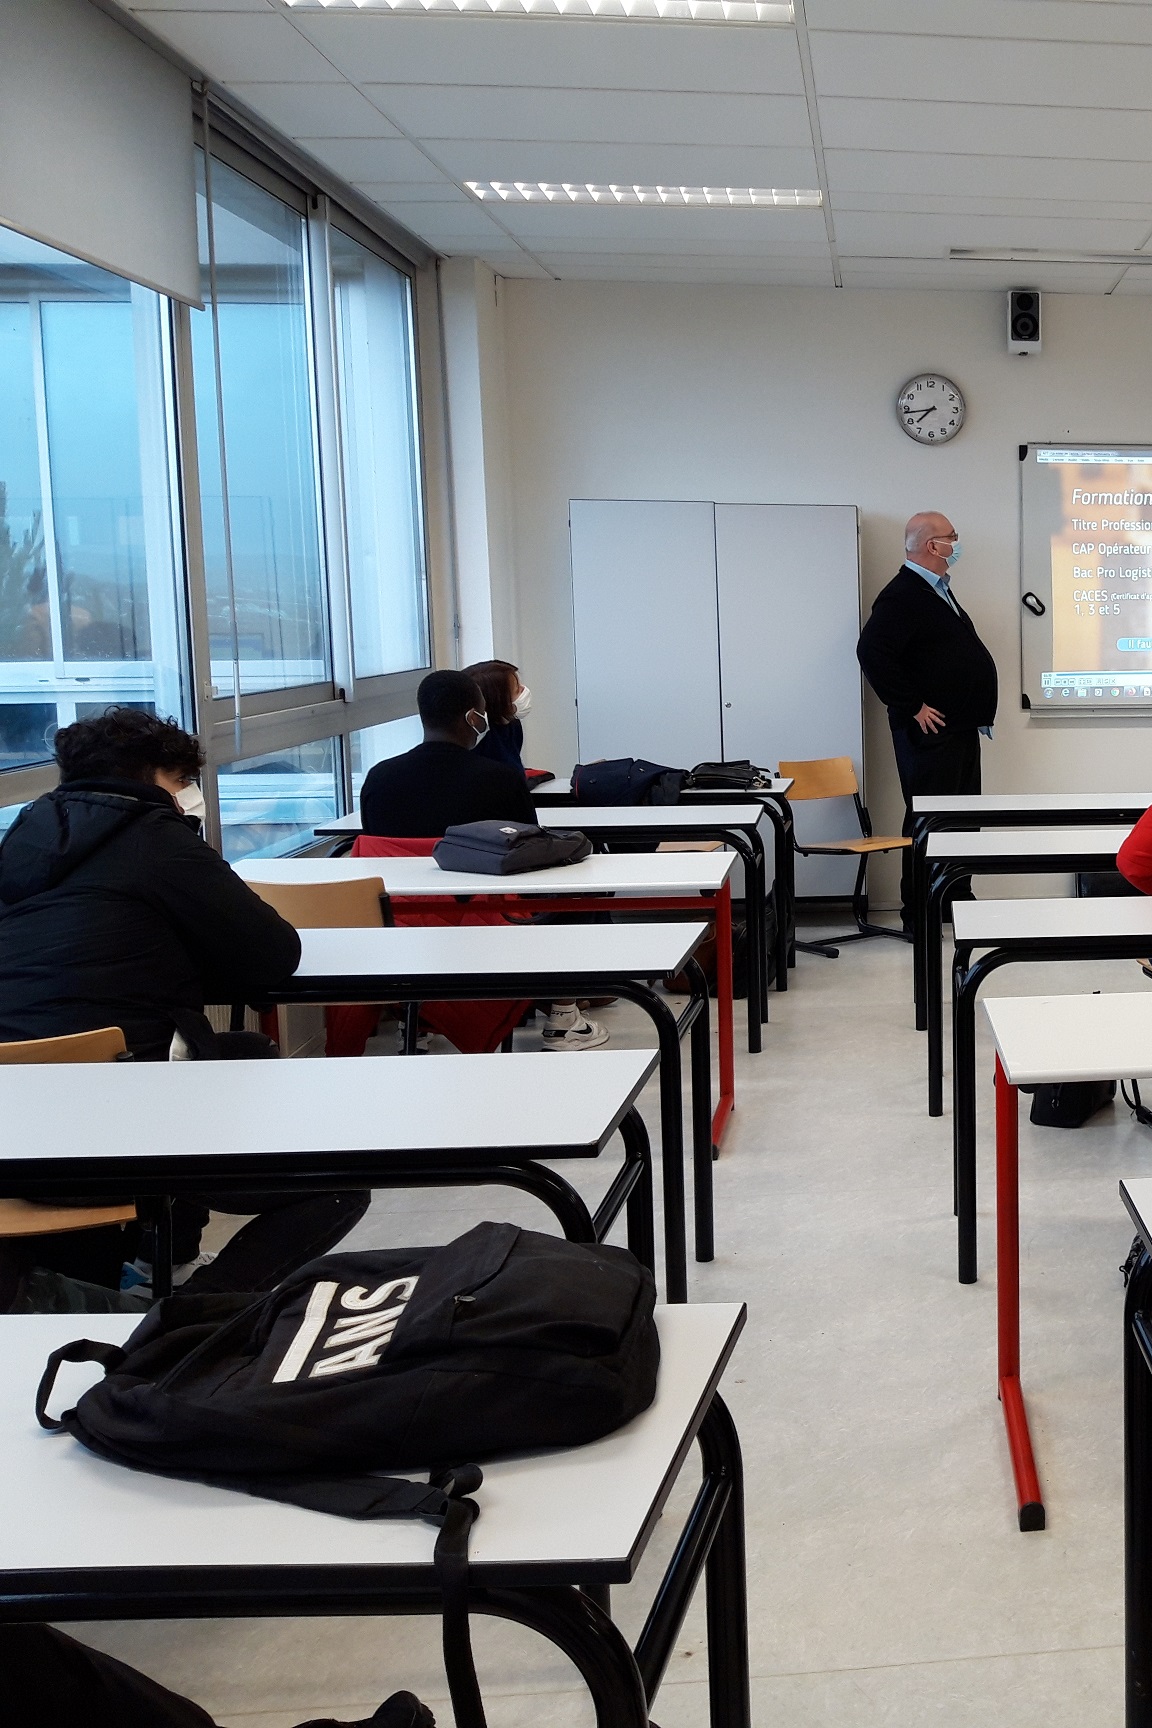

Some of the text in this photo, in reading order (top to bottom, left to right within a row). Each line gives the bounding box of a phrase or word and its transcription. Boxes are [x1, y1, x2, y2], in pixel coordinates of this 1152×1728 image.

[1072, 518, 1098, 531] Titre
[1072, 543, 1095, 555] CAP
[1098, 542, 1151, 557] Opérateur
[1073, 566, 1093, 578] Bac
[1097, 566, 1116, 578] Pro
[1073, 590, 1108, 602] CACES
[1110, 592, 1140, 602] (Certificat
[1074, 604, 1121, 617] 1, 3 et 5
[1128, 640, 1134, 649] Il
[272, 1275, 420, 1384] ANS
